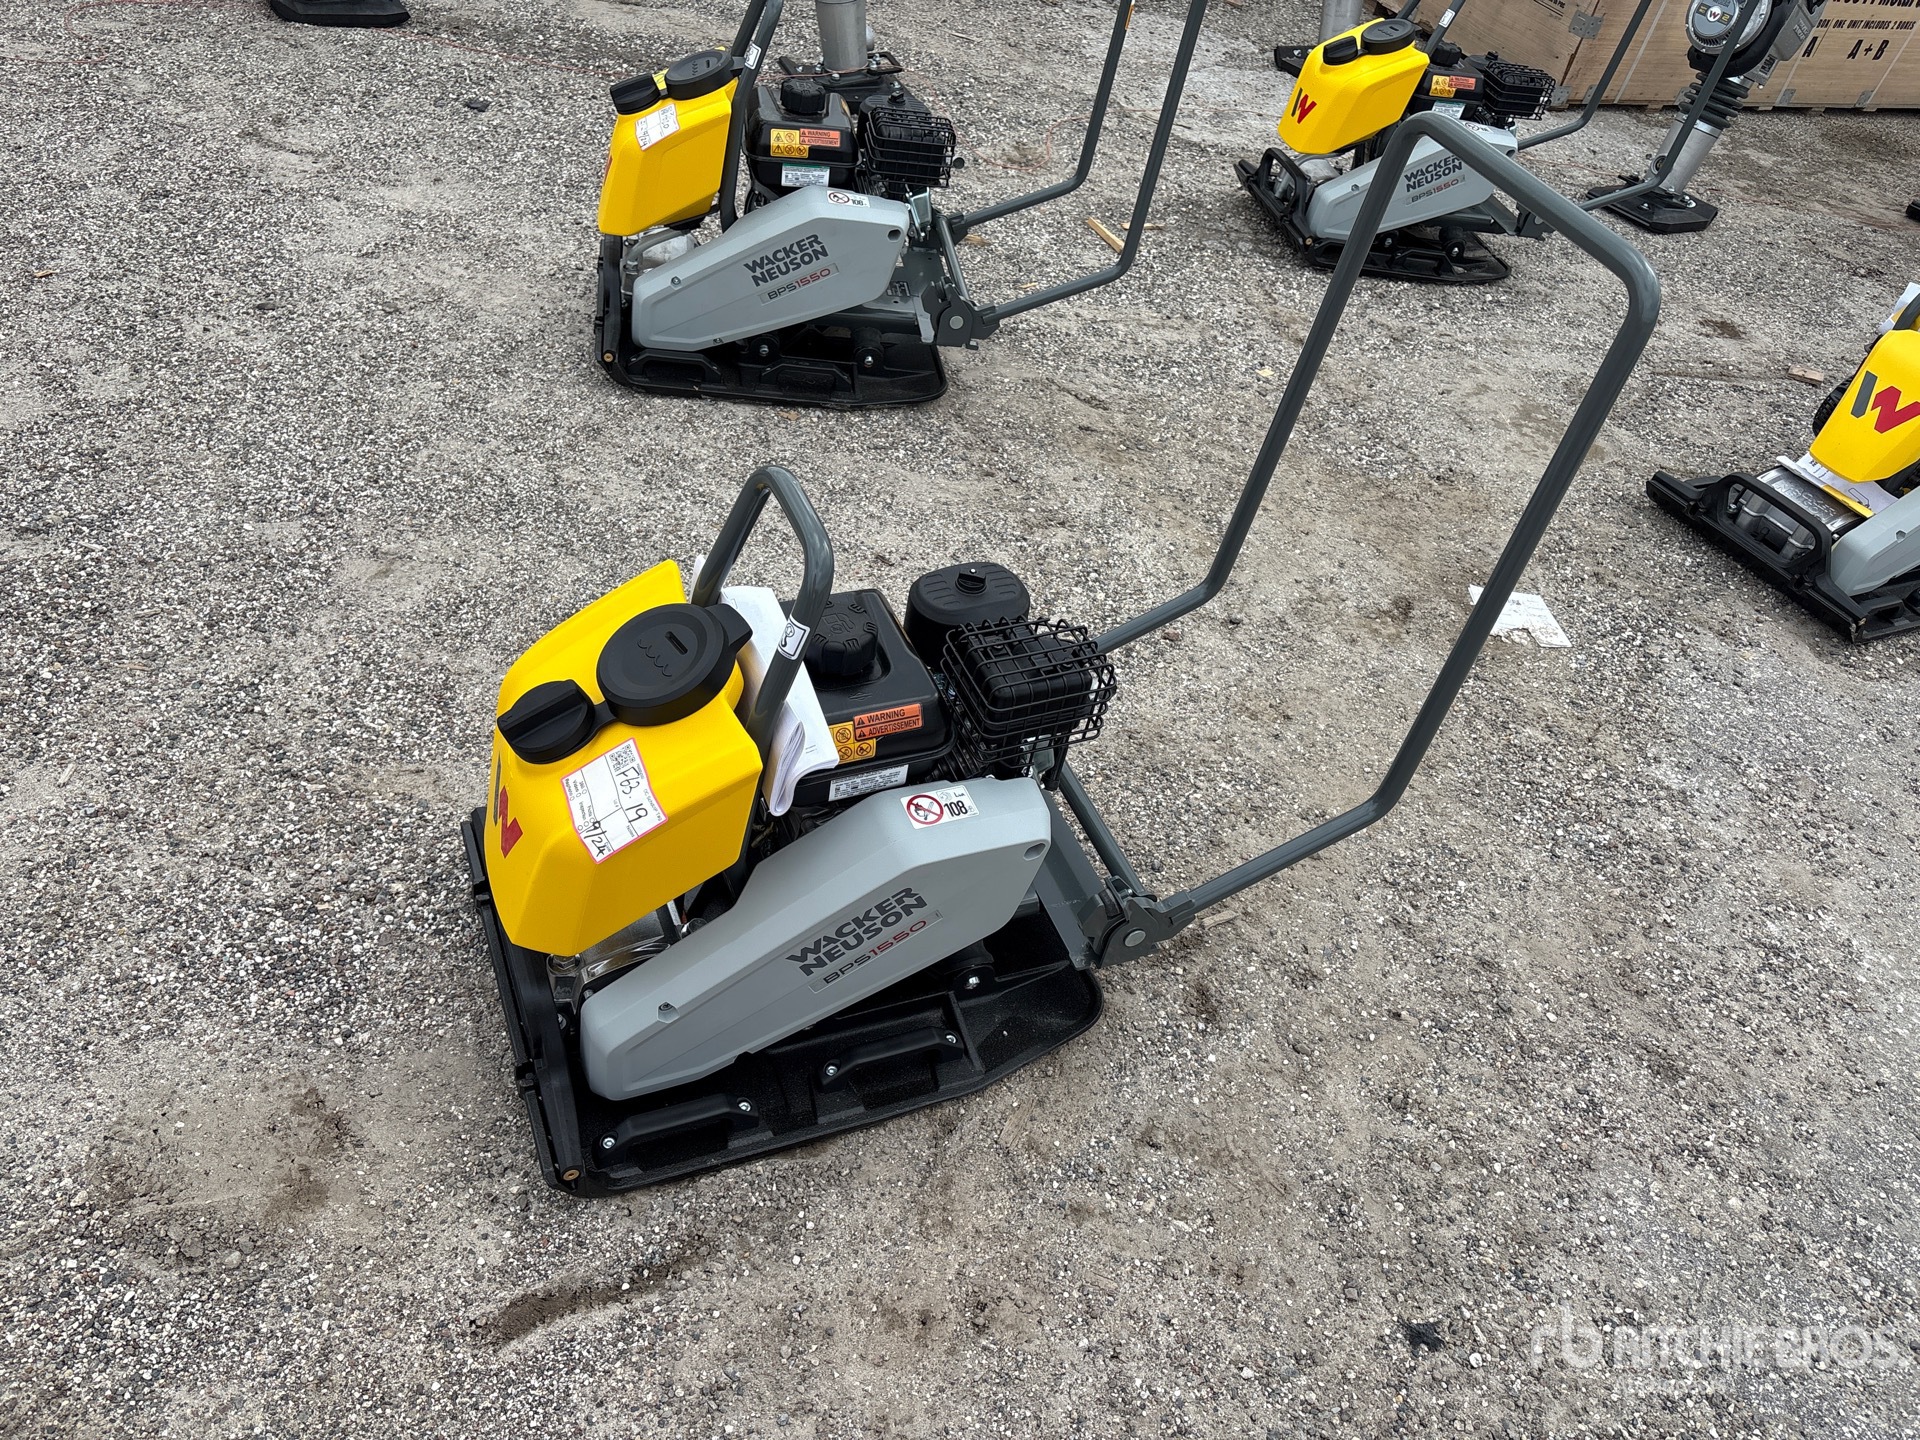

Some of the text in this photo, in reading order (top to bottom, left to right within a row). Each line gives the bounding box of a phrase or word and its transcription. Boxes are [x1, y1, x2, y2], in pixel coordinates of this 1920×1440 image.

[1832, 19, 1916, 30] ONE UNIT INCLUDES 2 BOXES
[1802, 36, 1819, 57] A
[1406, 162, 1463, 192] NEUSON
[1411, 179, 1459, 203] BPS1550
[743, 234, 823, 273] WACKER
[751, 245, 829, 287] NEUSON
[767, 268, 831, 300] BPS1550
[867, 709, 905, 723] WARNING
[868, 718, 920, 736] ADVERTISSEMENT
[625, 803, 648, 823] 19
[944, 800, 968, 817] 108
[785, 888, 919, 963] WACKER
[799, 896, 928, 976] NEUSON
[823, 920, 927, 984] BPS1550
